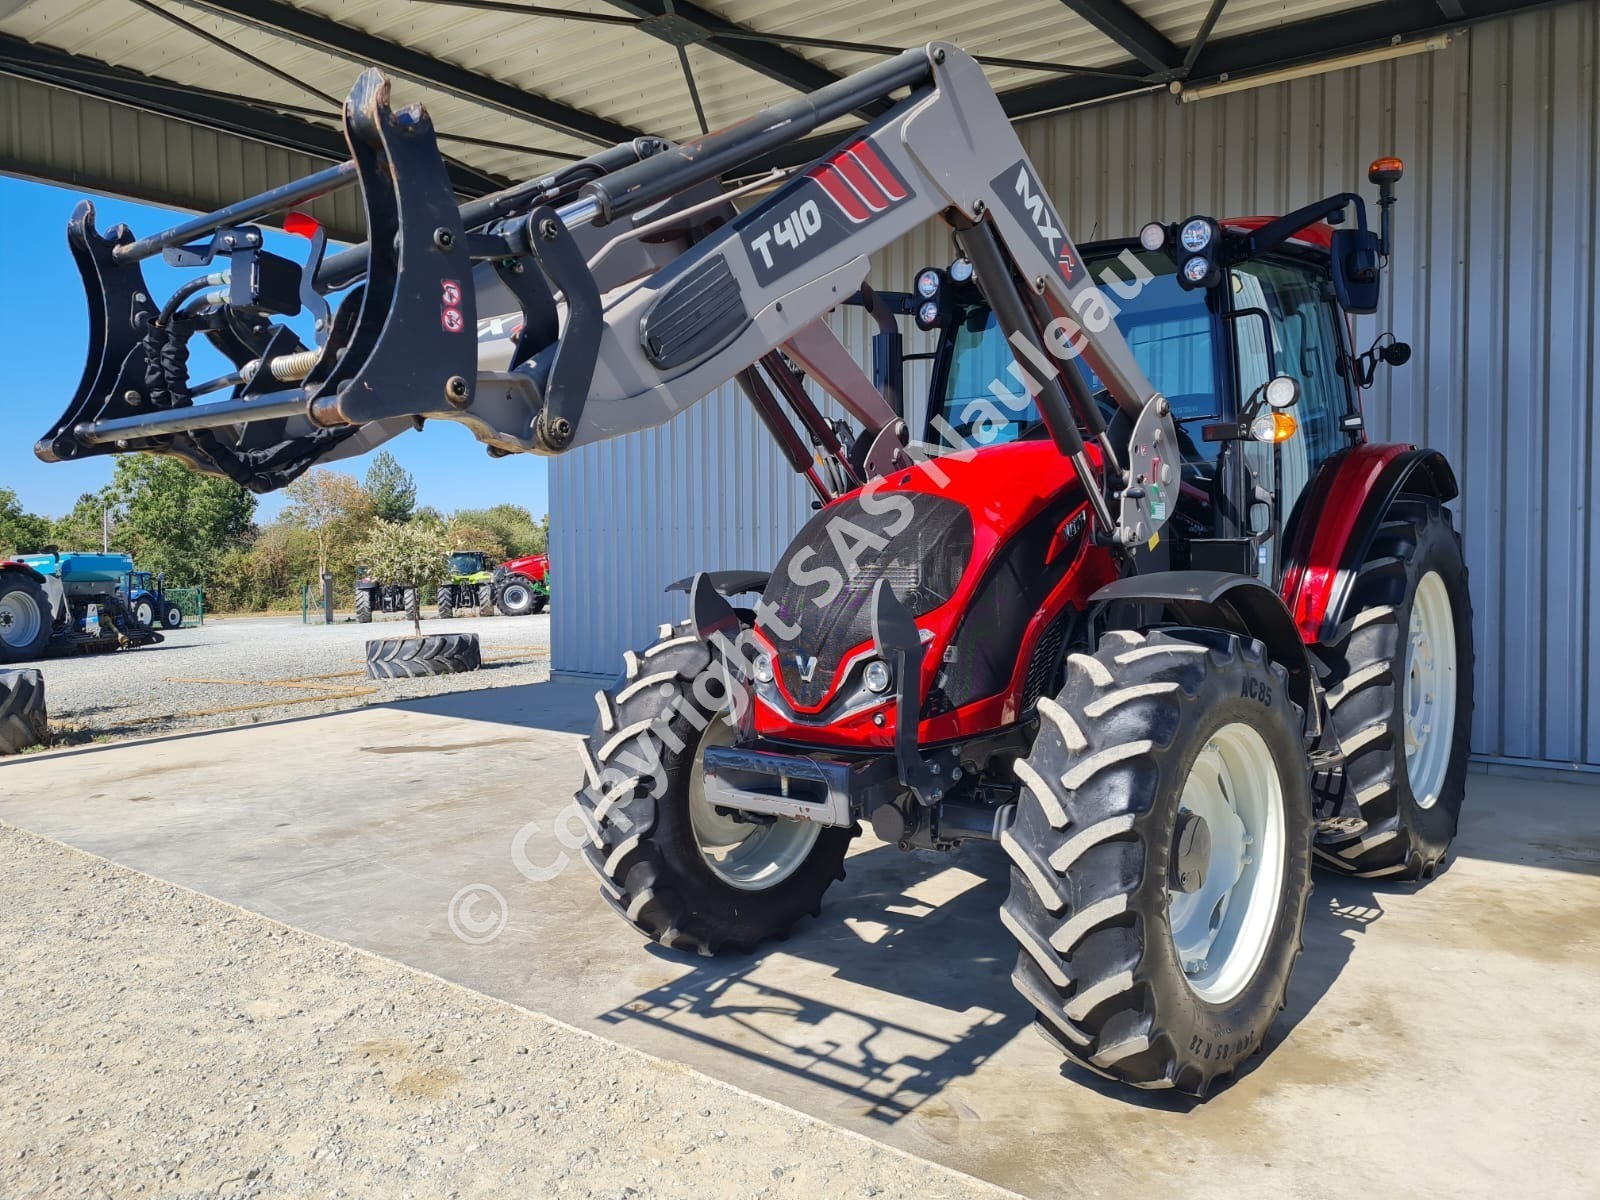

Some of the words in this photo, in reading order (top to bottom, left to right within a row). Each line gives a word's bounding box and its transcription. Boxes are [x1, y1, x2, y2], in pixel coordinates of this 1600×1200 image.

[751, 199, 821, 269] T410
[1015, 166, 1062, 257] MX
[1240, 675, 1272, 707] AC85
